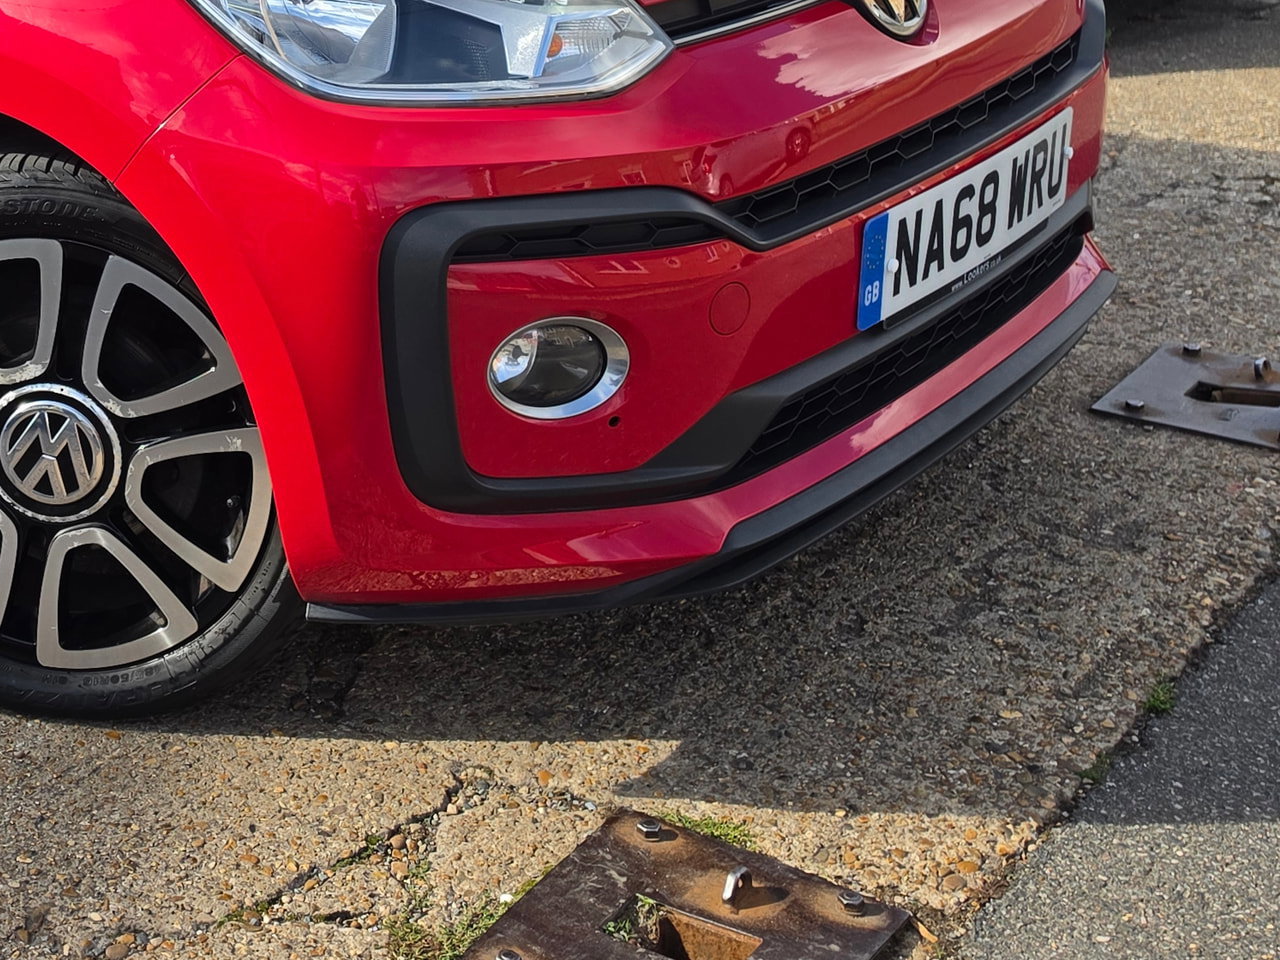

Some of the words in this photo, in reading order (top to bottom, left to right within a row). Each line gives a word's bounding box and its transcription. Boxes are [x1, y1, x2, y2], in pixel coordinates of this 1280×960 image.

[892, 169, 1000, 298] NA68
[1007, 123, 1068, 231] WRU
[864, 280, 880, 307] GB
